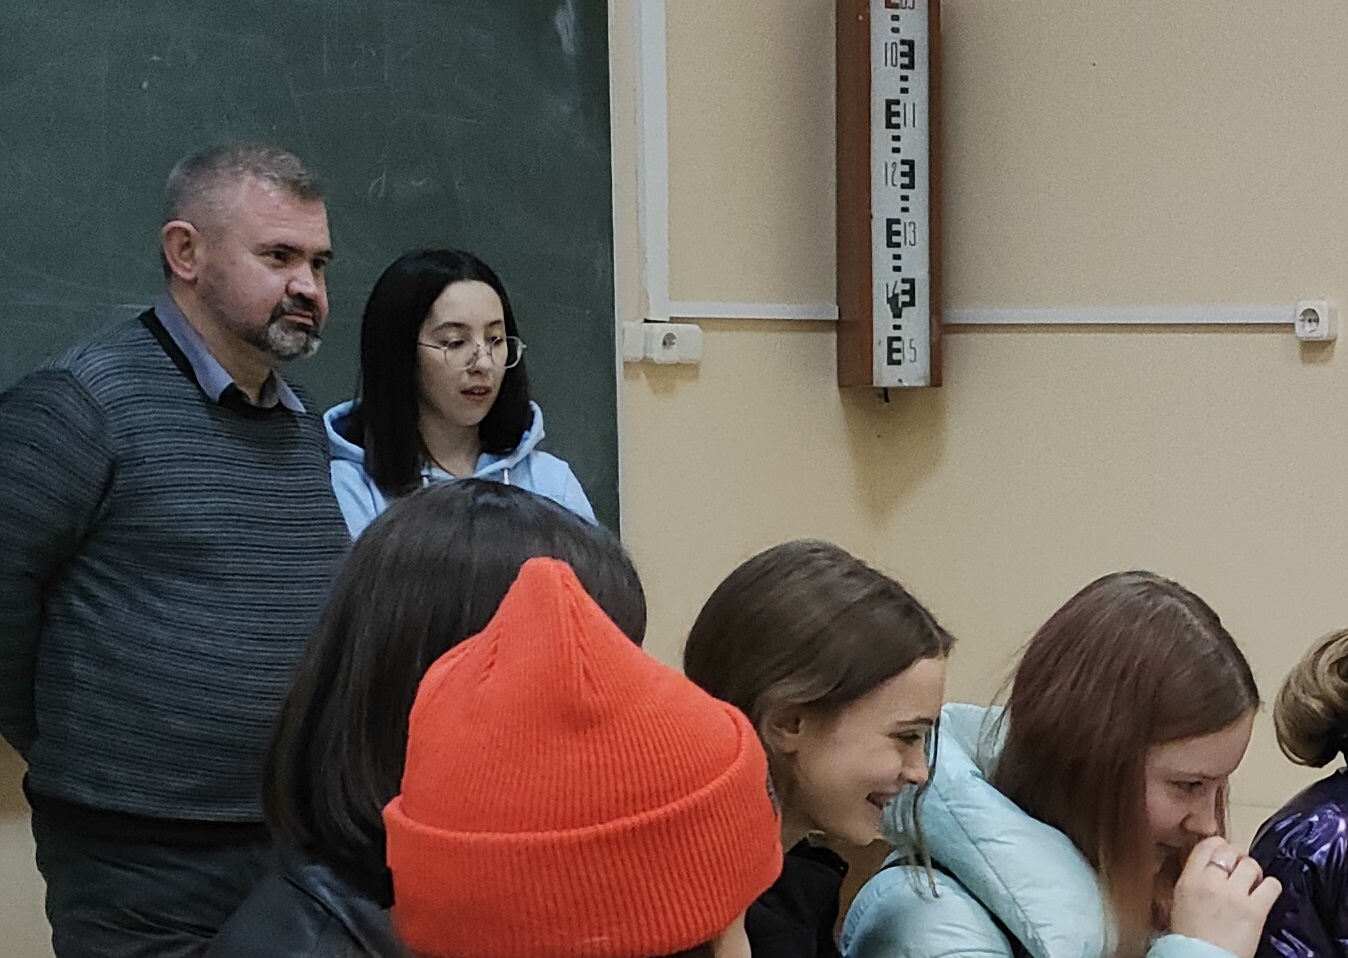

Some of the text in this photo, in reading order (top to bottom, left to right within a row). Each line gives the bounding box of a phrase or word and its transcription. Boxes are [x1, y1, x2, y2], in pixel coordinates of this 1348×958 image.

[885, 42, 898, 67] 10
[903, 102, 916, 128] 11
[885, 162, 898, 187] 12
[903, 221, 916, 247] 13
